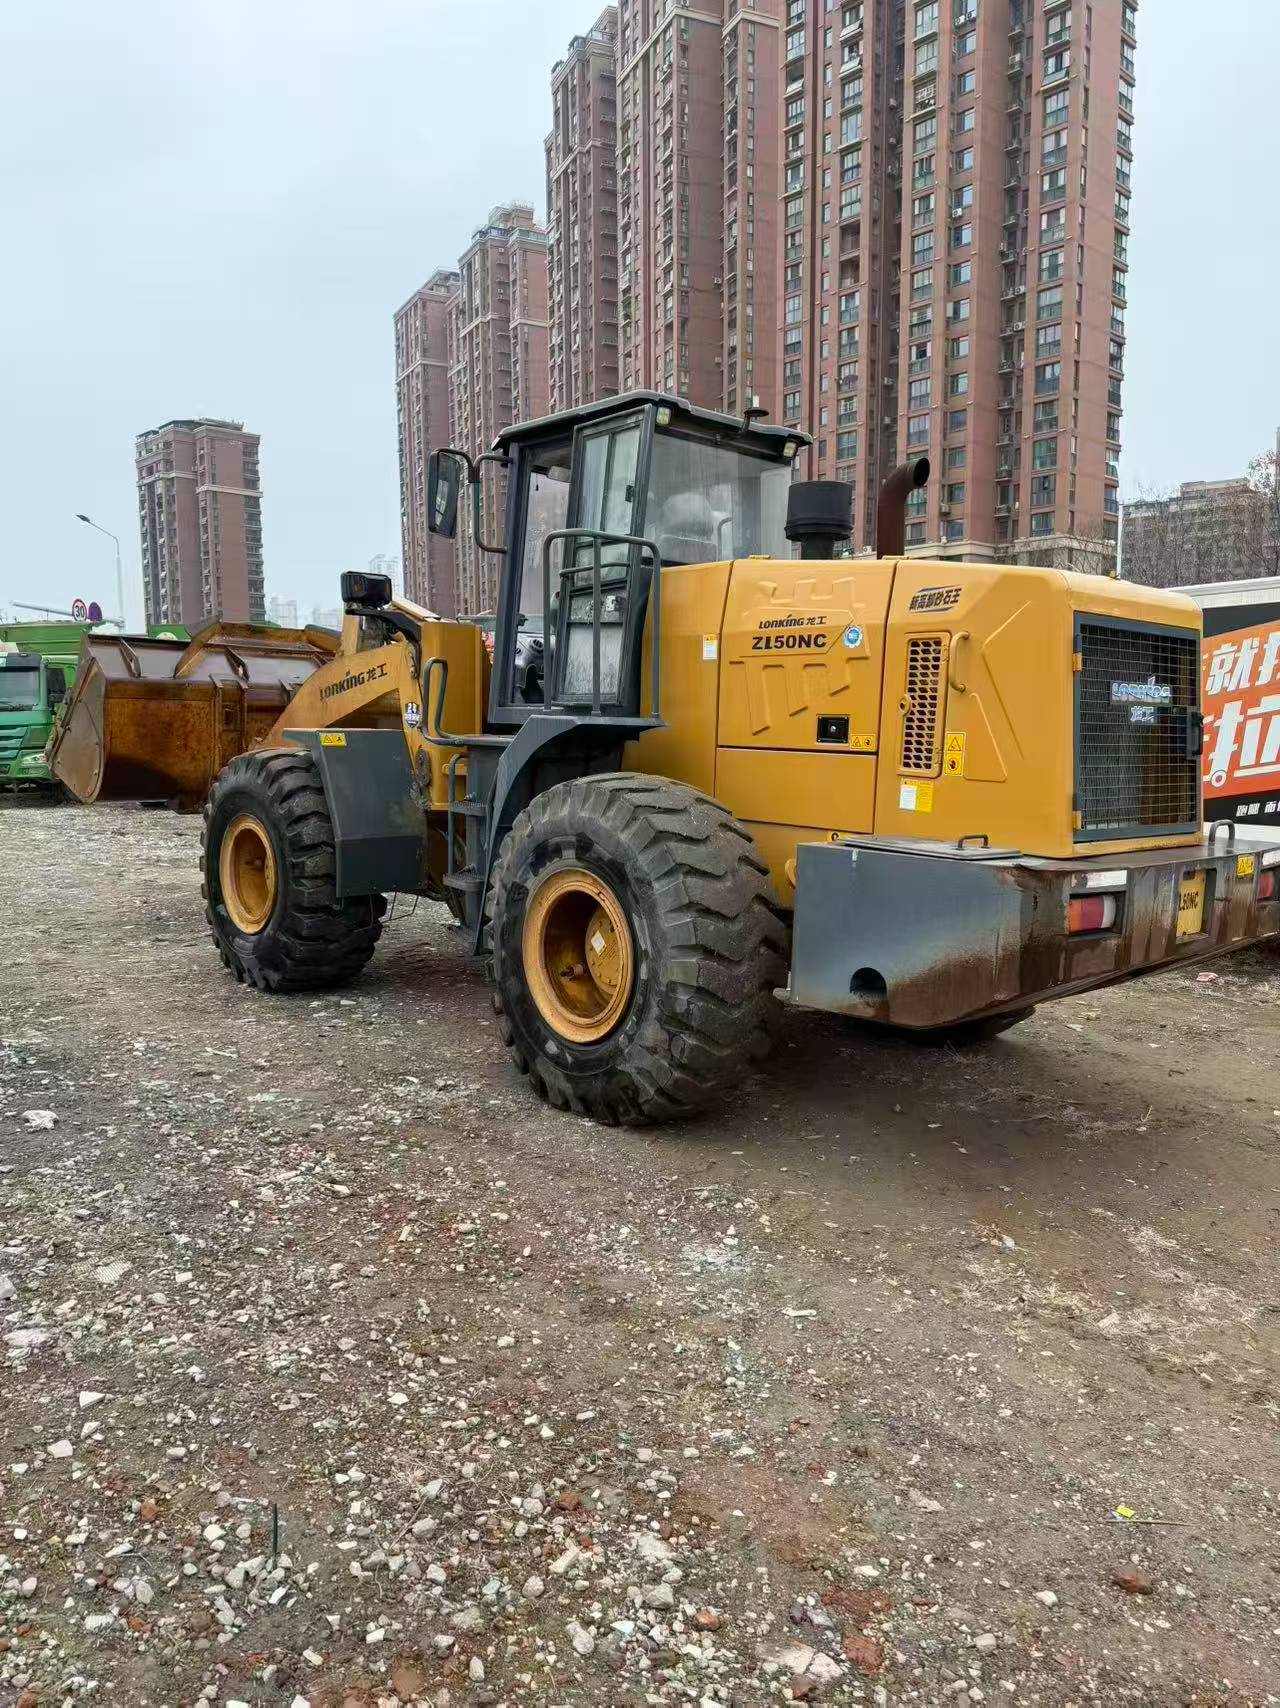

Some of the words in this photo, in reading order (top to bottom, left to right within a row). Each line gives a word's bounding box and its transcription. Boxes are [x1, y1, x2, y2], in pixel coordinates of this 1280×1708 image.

[75, 604, 85, 618] 30
[806, 616, 827, 627] 龙工
[752, 633, 827, 650] ZL50NC
[366, 663, 388, 682] 龙工
